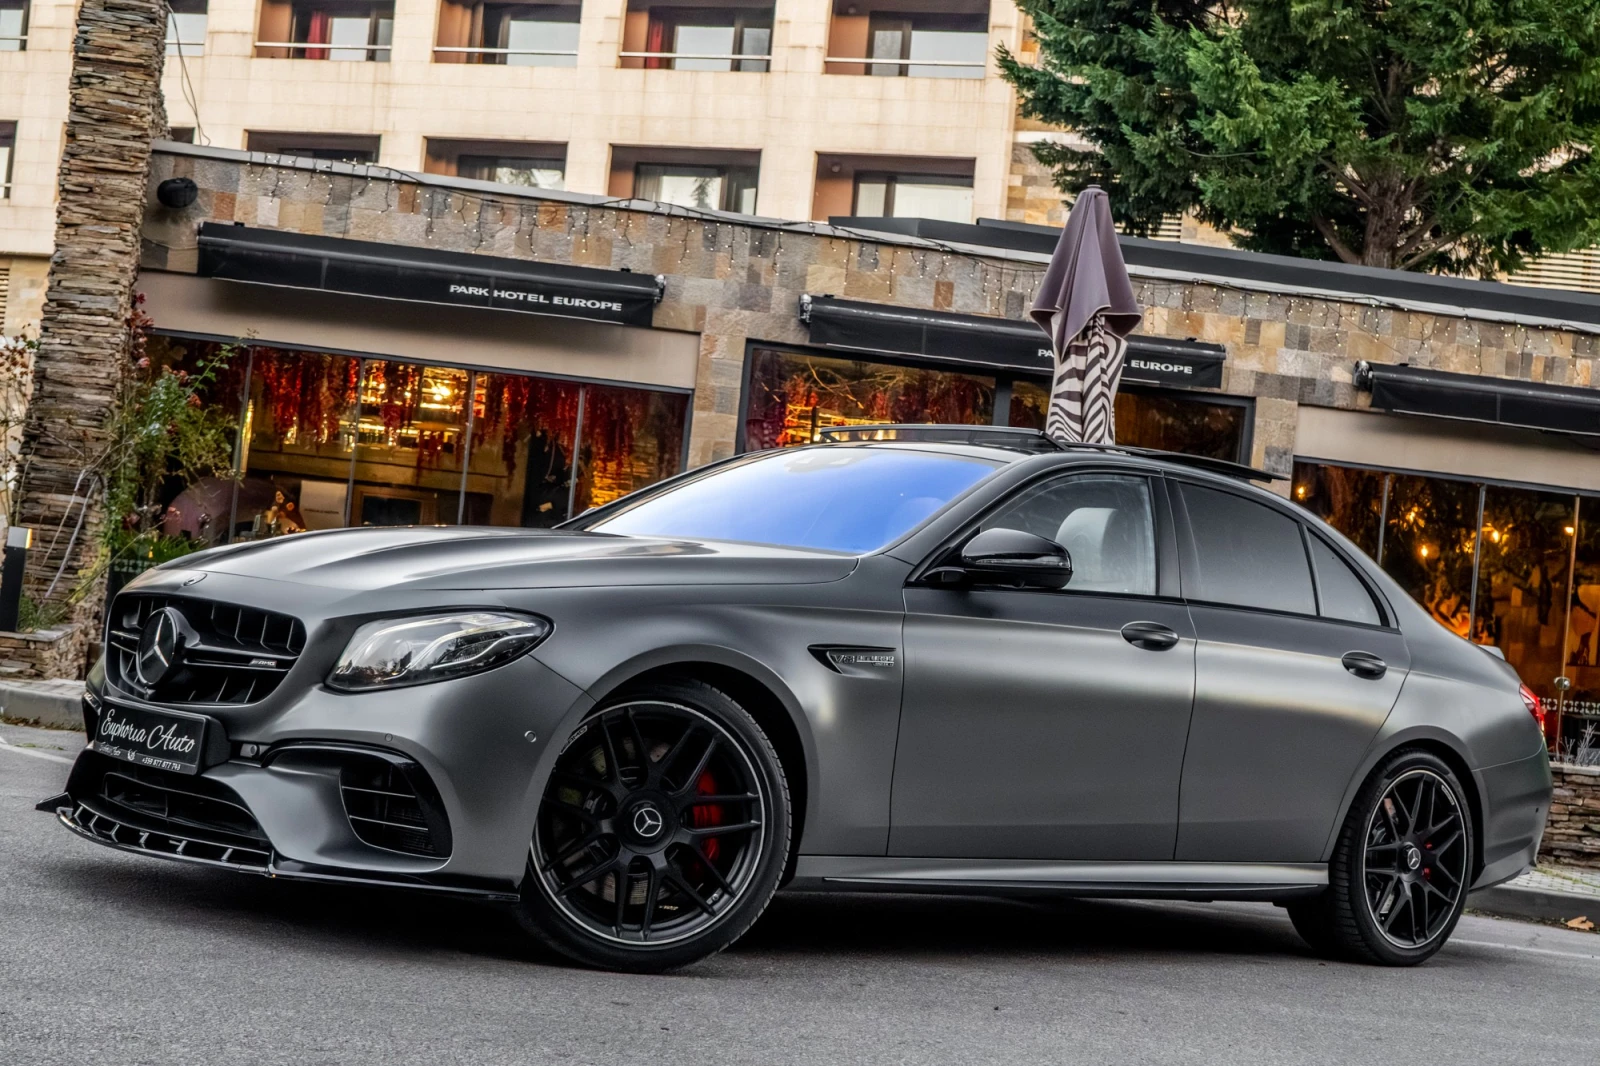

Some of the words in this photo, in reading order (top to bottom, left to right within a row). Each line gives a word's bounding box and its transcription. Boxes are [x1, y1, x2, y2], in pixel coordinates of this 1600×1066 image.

[450, 285, 489, 296] PARK
[493, 290, 549, 304] HOTEL
[552, 296, 622, 311] EUROPE
[1037, 349, 1055, 358] PA
[1131, 359, 1193, 374] EUROPE
[101, 708, 147, 742] Euphoria
[147, 723, 196, 753] Auto
